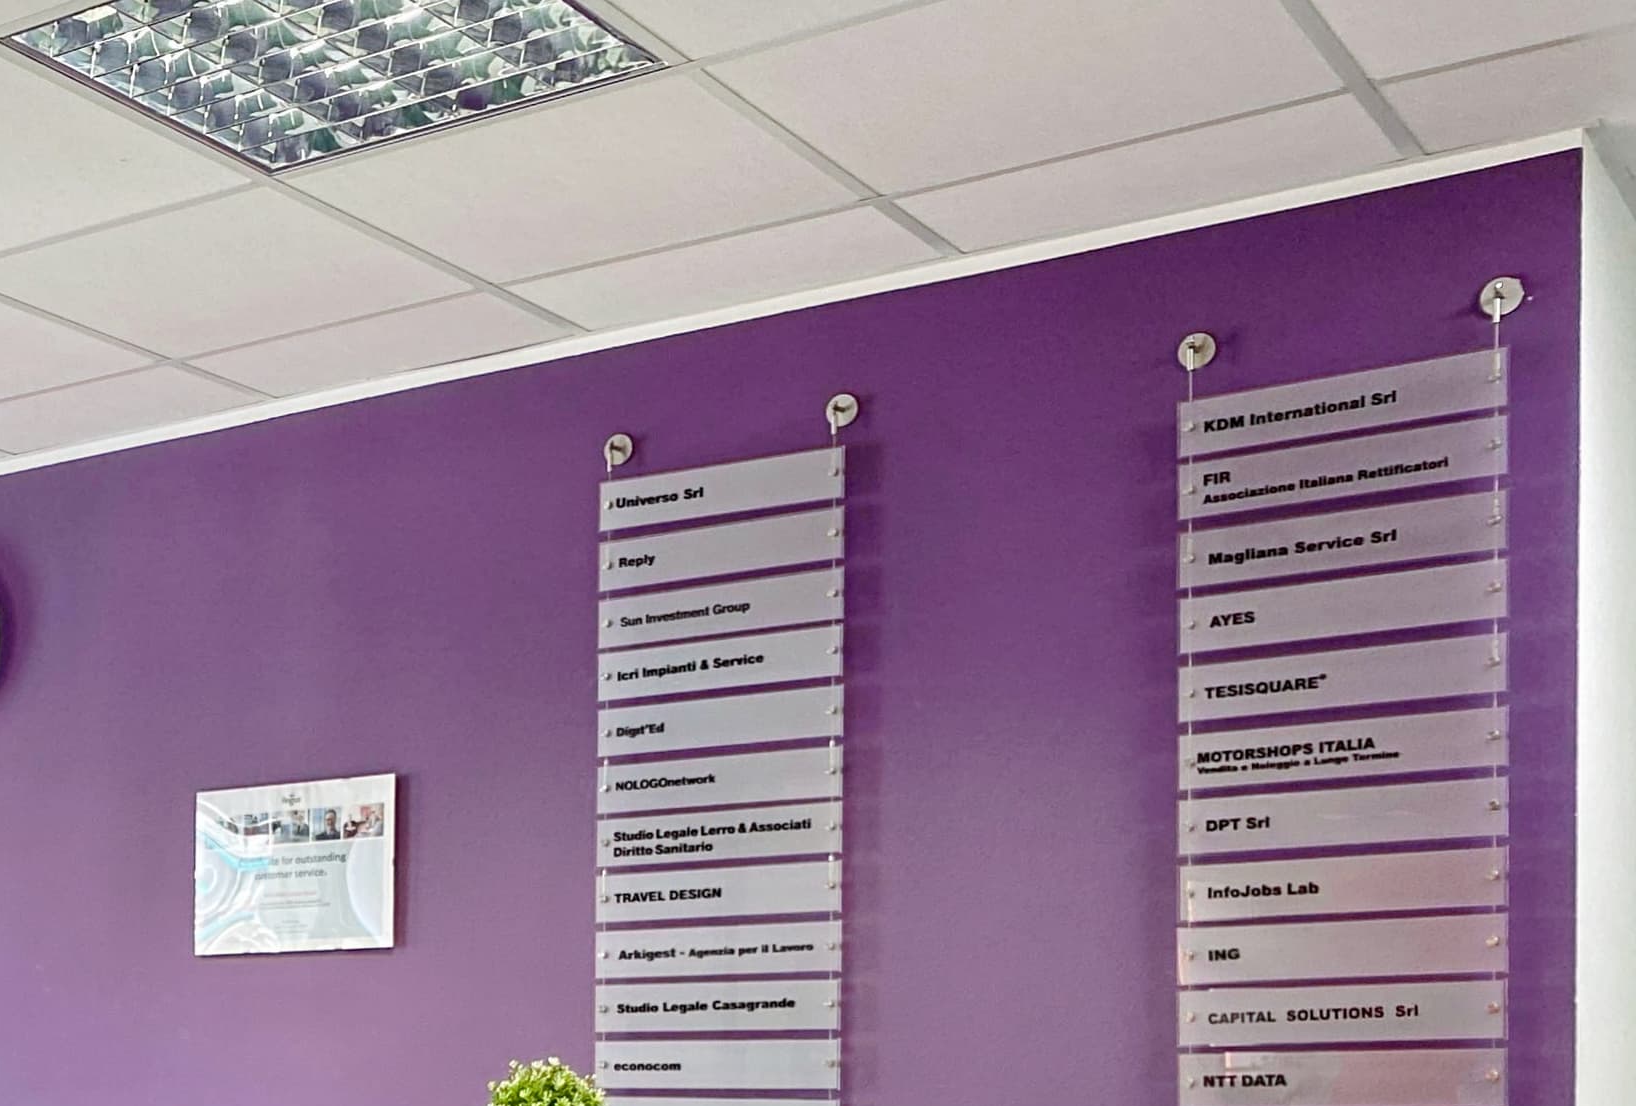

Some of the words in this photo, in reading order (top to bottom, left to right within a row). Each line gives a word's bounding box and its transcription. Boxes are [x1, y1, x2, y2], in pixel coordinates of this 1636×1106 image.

[1204, 416, 1244, 433] KDM
[1249, 395, 1365, 425] International
[1371, 390, 1396, 405] Srl
[1202, 481, 1296, 504] Associazione
[1299, 473, 1354, 489] Italiana
[1357, 457, 1449, 481] Rettificatori
[1203, 471, 1231, 486] FIR
[616, 493, 678, 508] Universo
[684, 487, 703, 499] Srl
[1209, 547, 1288, 565] Magliana
[1294, 537, 1364, 553] Service
[1370, 529, 1397, 543] Srl
[619, 554, 655, 568] Reply
[620, 617, 643, 627] Sun
[646, 606, 709, 624] Investment
[713, 603, 750, 615] Group
[1210, 611, 1255, 628] AYES
[617, 669, 639, 681] Icri
[643, 661, 696, 677] Impianti
[700, 660, 709, 670] &
[713, 655, 764, 668] Service
[1196, 743, 1313, 763] MOTORSHOPS
[1318, 737, 1376, 753] ITALIA
[616, 774, 715, 790] NOLOGOnetwork
[614, 830, 654, 843] Studio
[655, 826, 699, 840] Legale
[700, 825, 736, 836] Lerro
[738, 823, 746, 833] &
[749, 819, 811, 832] Associati
[1206, 818, 1241, 832] DPT
[1246, 816, 1270, 829] Srl
[614, 846, 654, 857] Diritto
[655, 841, 713, 855] Sanitario
[294, 851, 347, 865] outstanding
[614, 891, 665, 903] TRAVEL
[669, 888, 722, 900] DESIGN
[1208, 884, 1282, 899] InfoJobs
[1287, 882, 1319, 895] Lab
[619, 948, 676, 961] Arkigest
[738, 947, 758, 957] per
[772, 944, 814, 952] Lavoro
[1209, 948, 1240, 961] ING
[617, 1003, 659, 1013] Studio
[663, 1001, 708, 1014] Legale
[712, 998, 795, 1011] Casagrande
[1208, 1011, 1276, 1024] CAPITAL
[1287, 1006, 1384, 1021] SOLUTIONS
[1396, 1005, 1418, 1017] Srl
[614, 1063, 681, 1071] econocom
[1204, 1075, 1237, 1088] NTT
[1242, 1074, 1287, 1087] DATA
